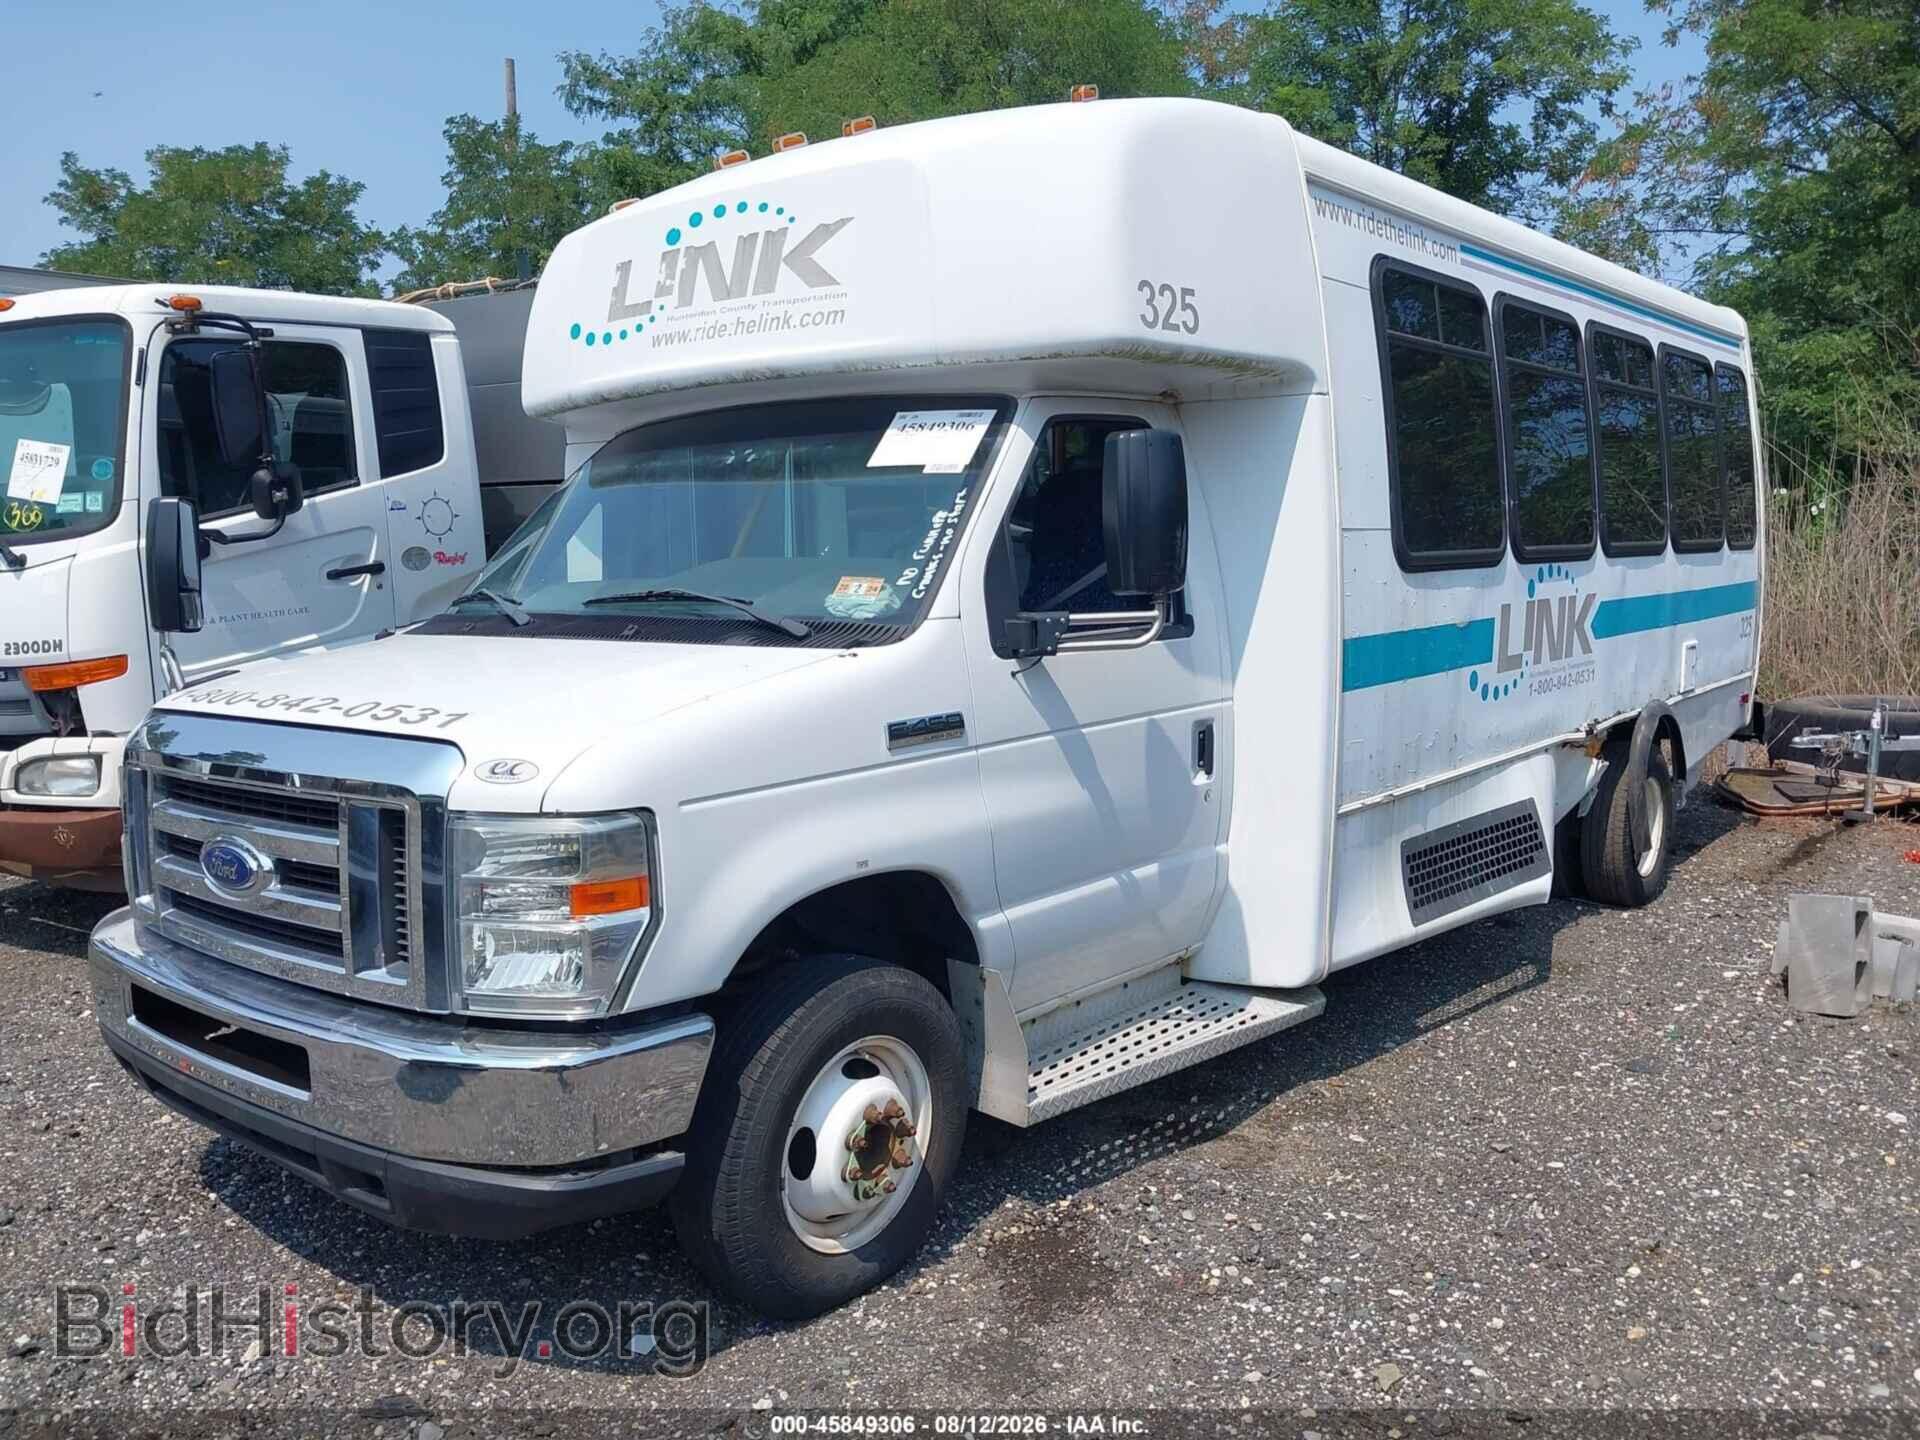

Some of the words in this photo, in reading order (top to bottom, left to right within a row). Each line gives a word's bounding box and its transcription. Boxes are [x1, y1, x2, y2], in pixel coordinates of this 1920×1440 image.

[1314, 196, 1457, 262] www.ridethelink.com
[608, 216, 855, 323] LINK
[719, 302, 757, 315] County
[761, 292, 848, 309] Transportation
[1137, 279, 1199, 335] 325
[896, 420, 976, 433] 45849306
[219, 612, 249, 625] PLANT
[287, 606, 310, 617] CARE
[1497, 593, 1596, 674] LINK
[1529, 666, 1595, 697] 1-800-842-0531
[171, 687, 469, 729] 1-800-842-0531
[207, 848, 240, 880] Ford
